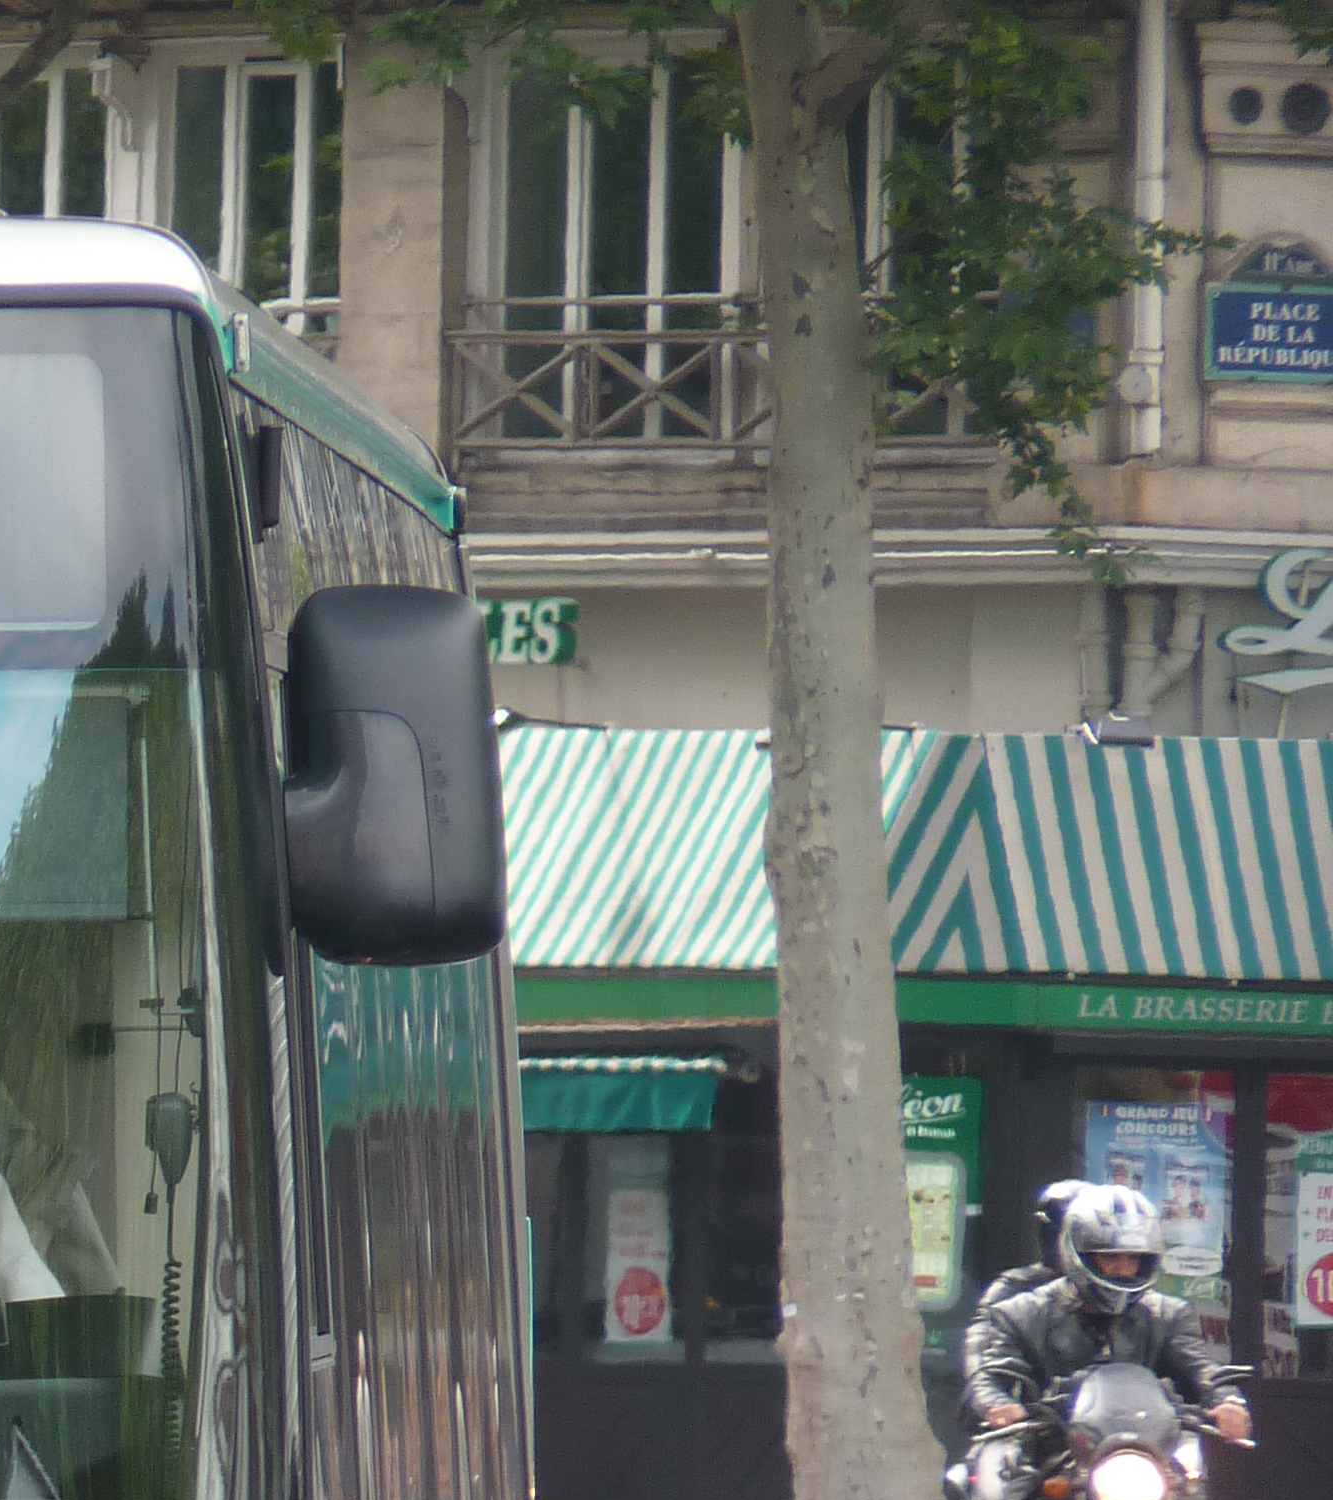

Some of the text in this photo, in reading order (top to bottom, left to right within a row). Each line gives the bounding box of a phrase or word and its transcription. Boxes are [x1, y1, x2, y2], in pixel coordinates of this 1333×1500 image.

[1250, 301, 1320, 322] PLACE
[1253, 323, 1314, 344] DE LA
[1077, 994, 1119, 1020] LA
[1132, 995, 1309, 1024] BRASSERIE
[899, 1083, 965, 1119] éon
[1115, 1105, 1199, 1122] GRAND JEU
[1115, 1121, 1198, 1136] CONCOURS
